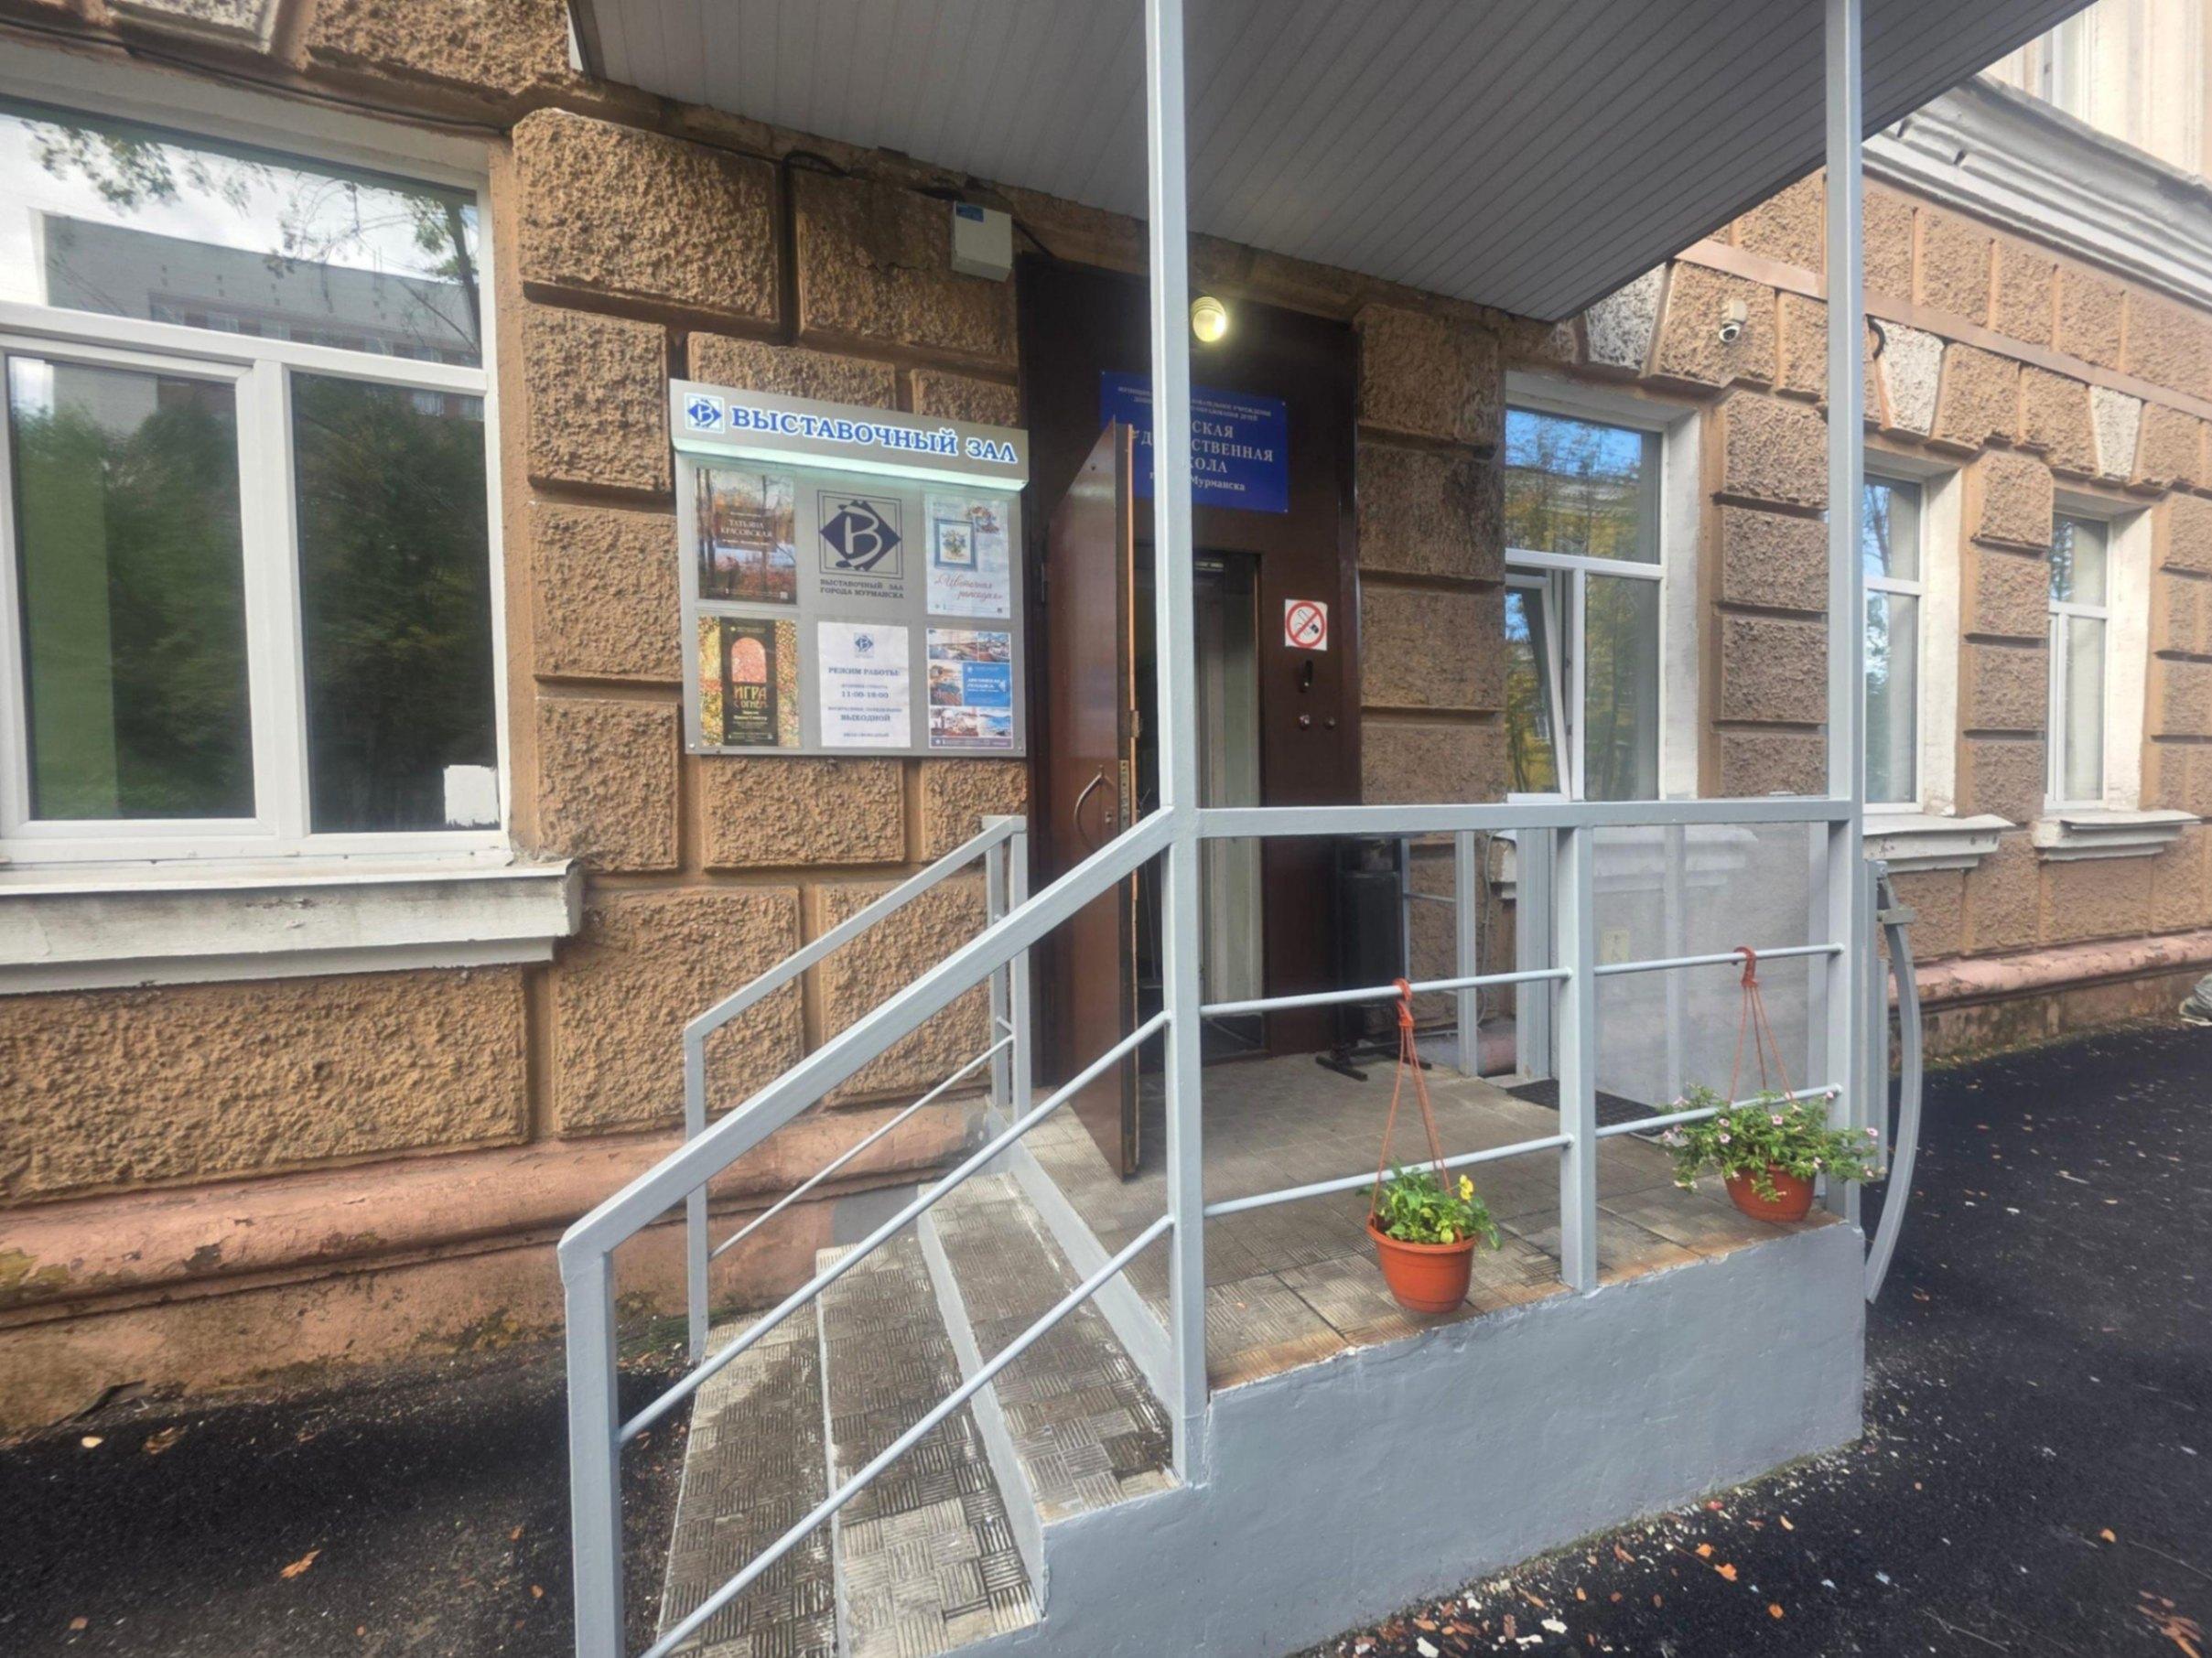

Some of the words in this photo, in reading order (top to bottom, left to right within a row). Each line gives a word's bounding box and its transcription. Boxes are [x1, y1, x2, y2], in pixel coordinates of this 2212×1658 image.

[731, 406, 958, 455] ВЫСТАВОЧНЫЙ
[966, 440, 1018, 463] ЗАЛ
[1192, 420, 1234, 439] СКАЯ
[1191, 457, 1228, 474] ОЛА
[820, 578, 883, 589] ВЫСТАВОЧНЫЙ
[820, 587, 853, 595] ГОРОДА
[855, 589, 904, 599] МУРМАНСКА
[828, 666, 862, 675] РЕЖИМ
[734, 685, 767, 701] ИГРА
[840, 714, 891, 722] ВЫХОДНОЙ
